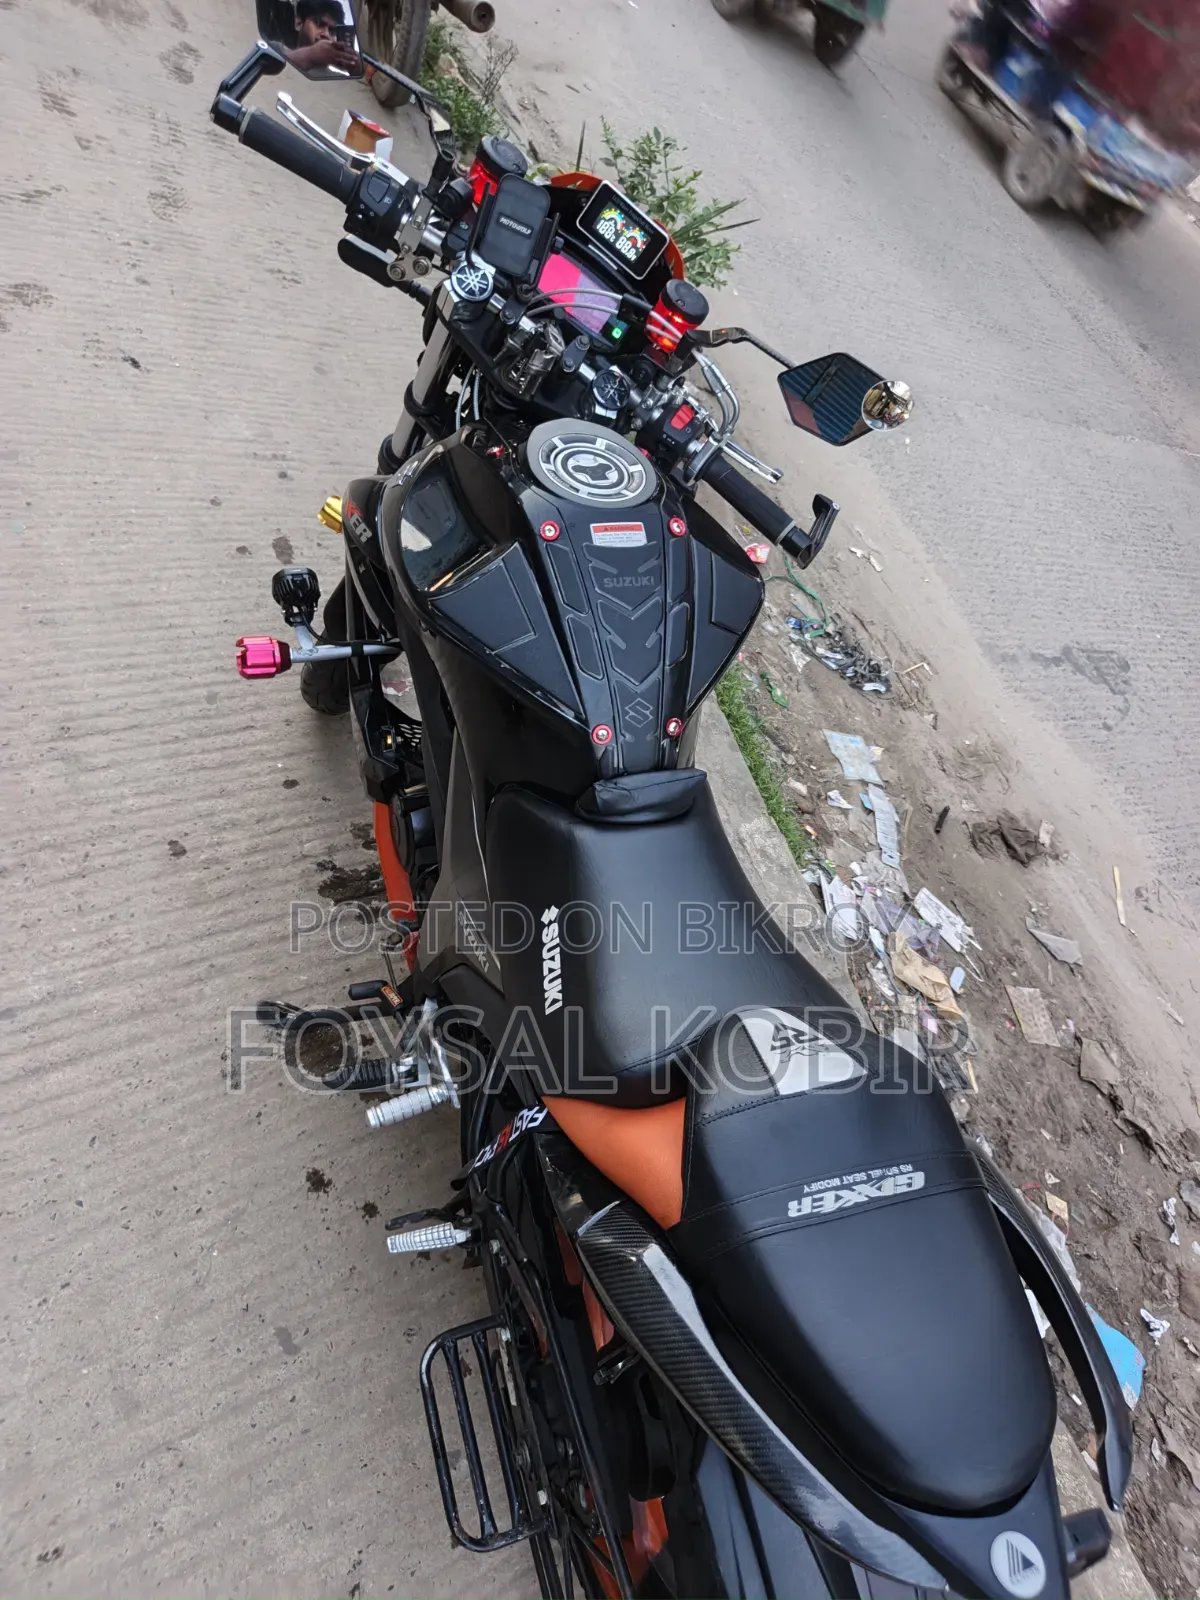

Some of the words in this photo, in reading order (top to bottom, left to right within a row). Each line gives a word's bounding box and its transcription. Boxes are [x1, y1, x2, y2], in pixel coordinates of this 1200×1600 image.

[603, 576, 655, 588] SUZUKI
[541, 921, 563, 1016] SUZUKI
[899, 1163, 914, 1173] RS
[803, 1177, 842, 1194] MODIFY
[842, 1172, 868, 1185] SEAT
[787, 1171, 926, 1218] GIXXER
